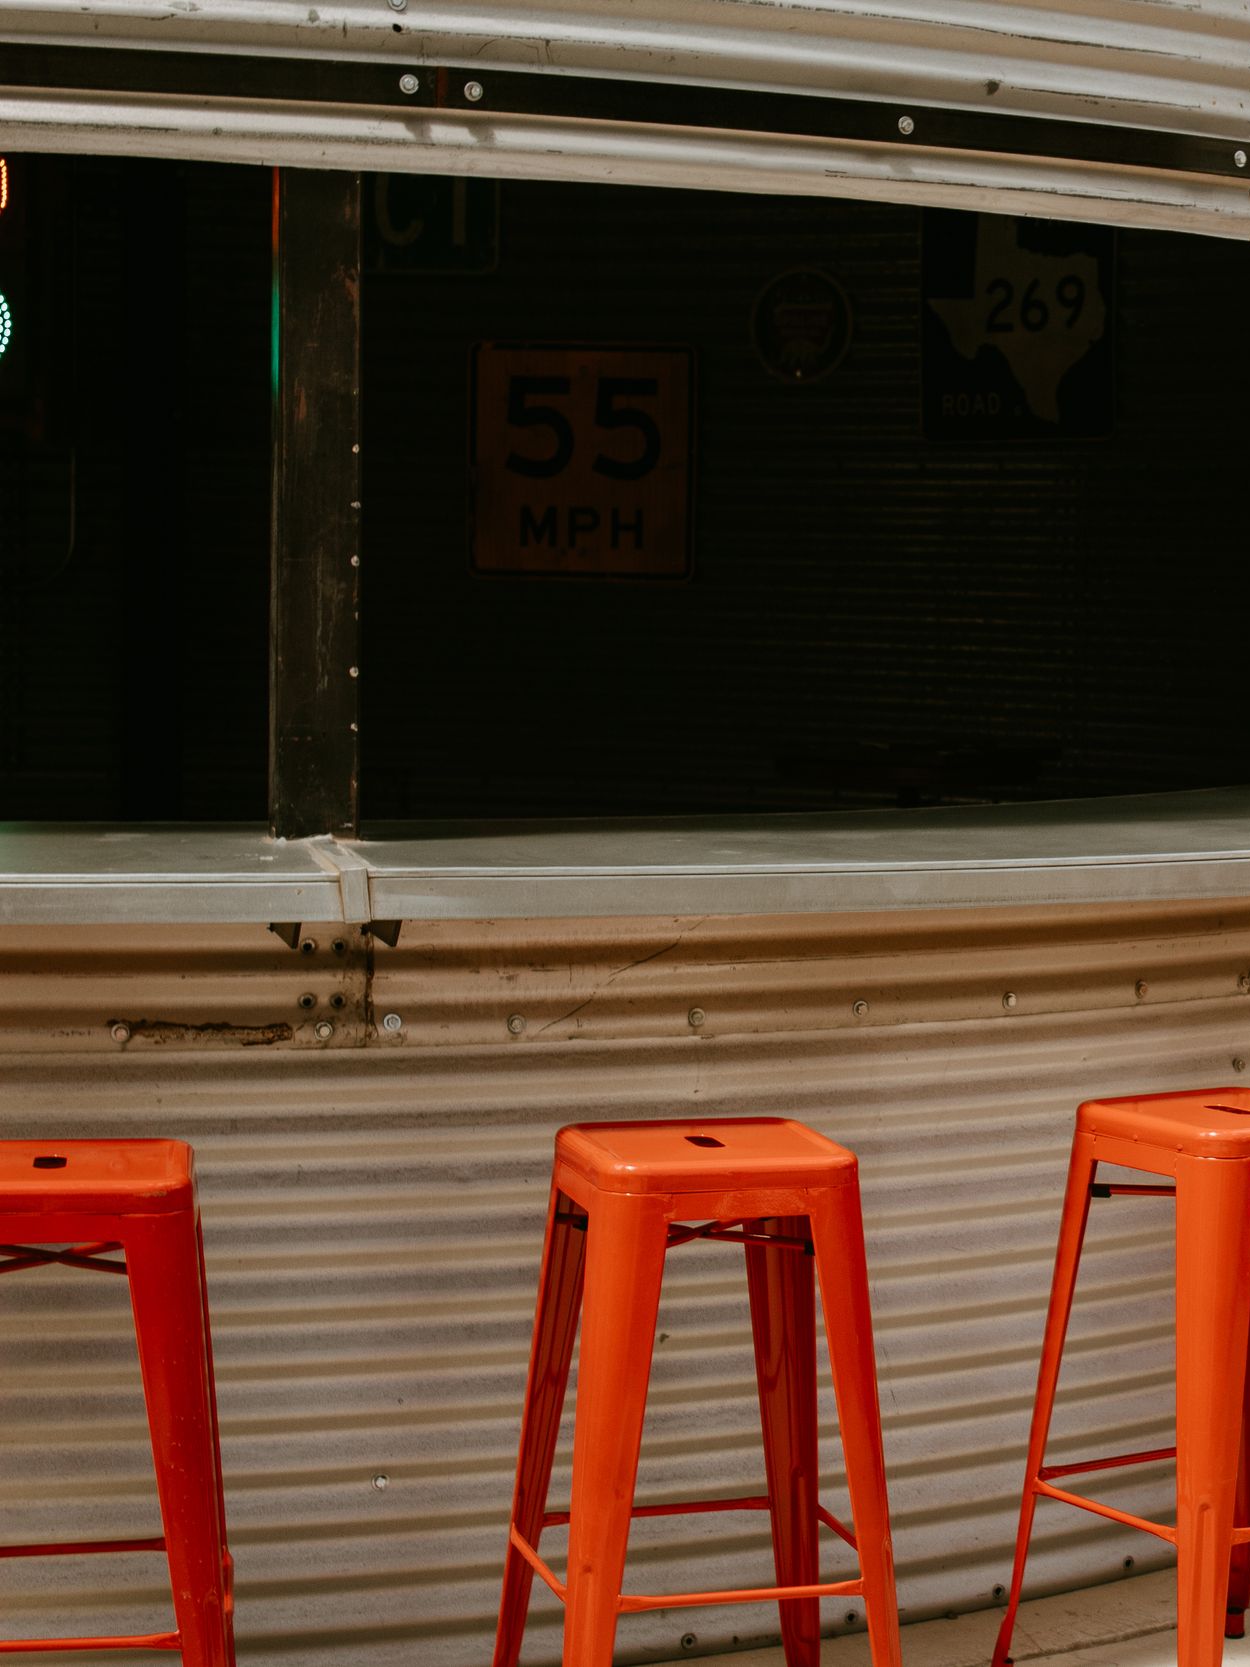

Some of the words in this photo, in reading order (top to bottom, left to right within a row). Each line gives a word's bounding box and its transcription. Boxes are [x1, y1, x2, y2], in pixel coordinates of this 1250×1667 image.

[986, 275, 1085, 332] 269
[506, 377, 661, 480] 55
[941, 392, 1001, 417] ROAD
[520, 504, 643, 549] MPH
